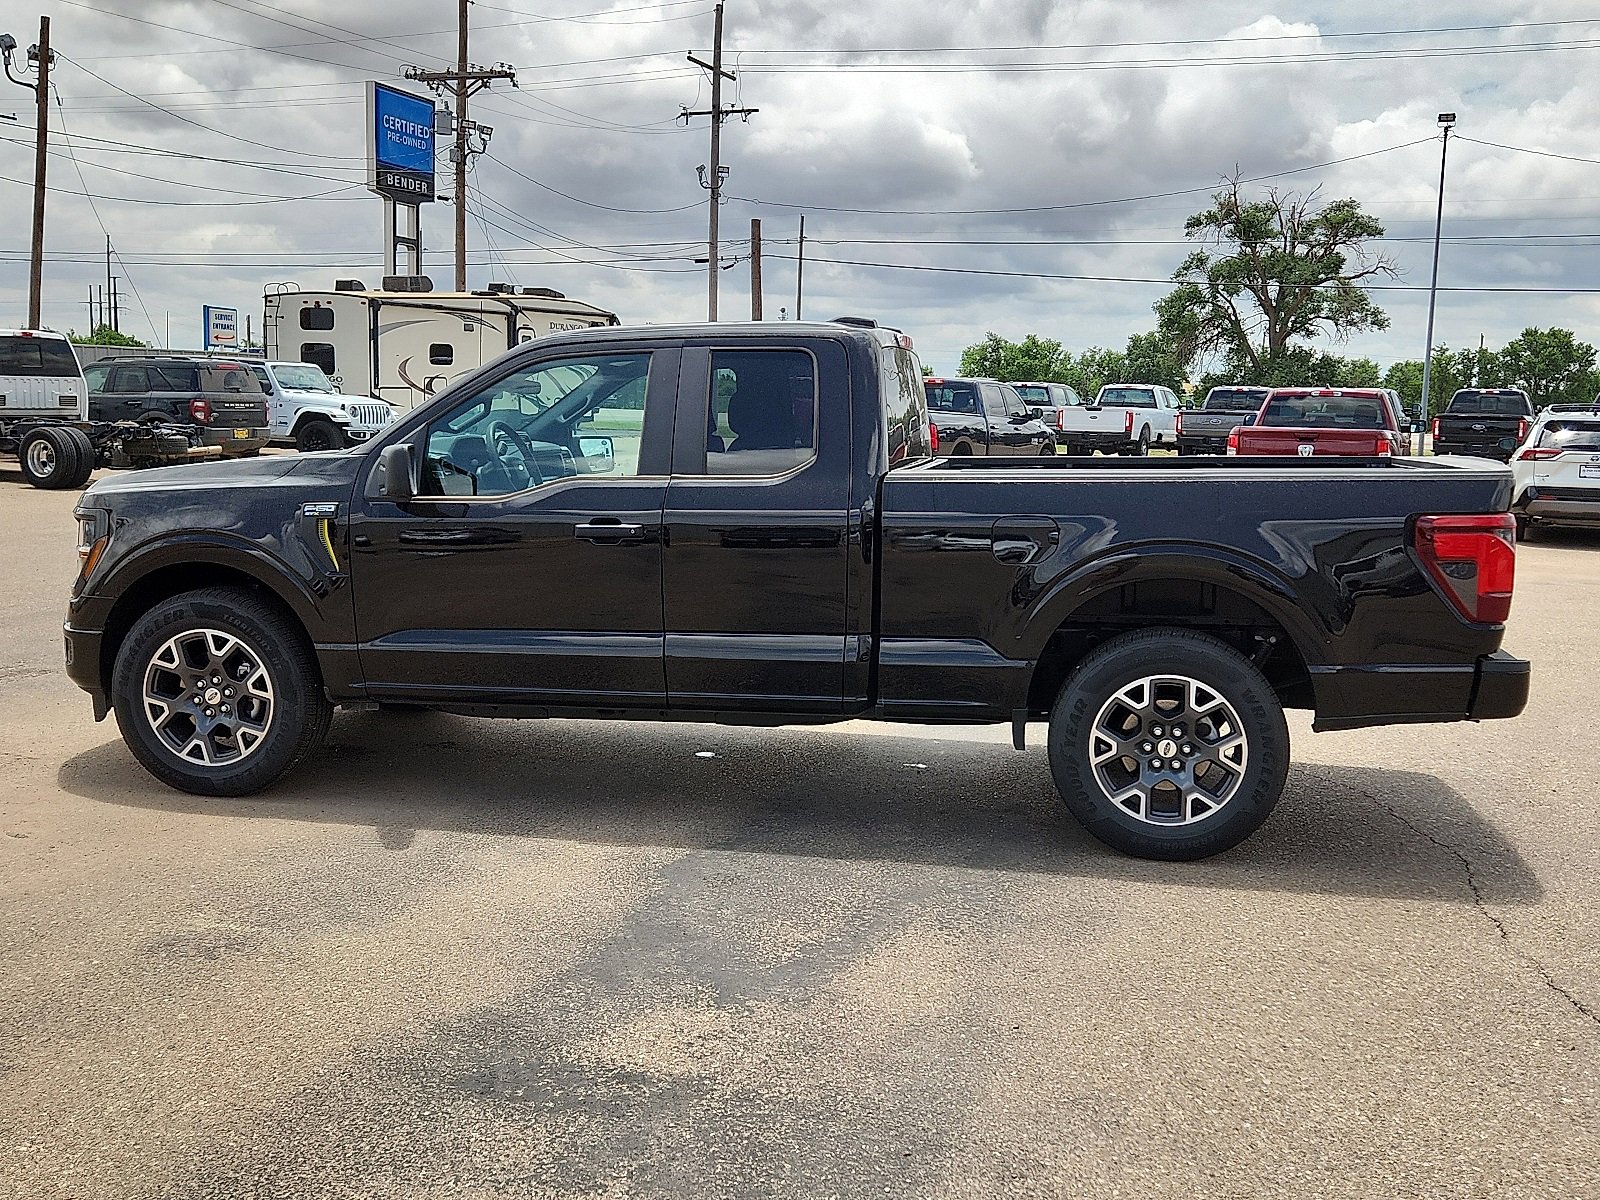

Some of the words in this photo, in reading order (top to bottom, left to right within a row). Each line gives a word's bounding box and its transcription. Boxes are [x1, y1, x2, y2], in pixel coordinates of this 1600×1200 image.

[383, 114, 430, 139] CERTIFIED
[387, 131, 427, 150] PRE-OWNED
[387, 173, 428, 194] BENDER
[212, 322, 235, 331] ENTRANCE
[214, 313, 234, 322] SERVICE
